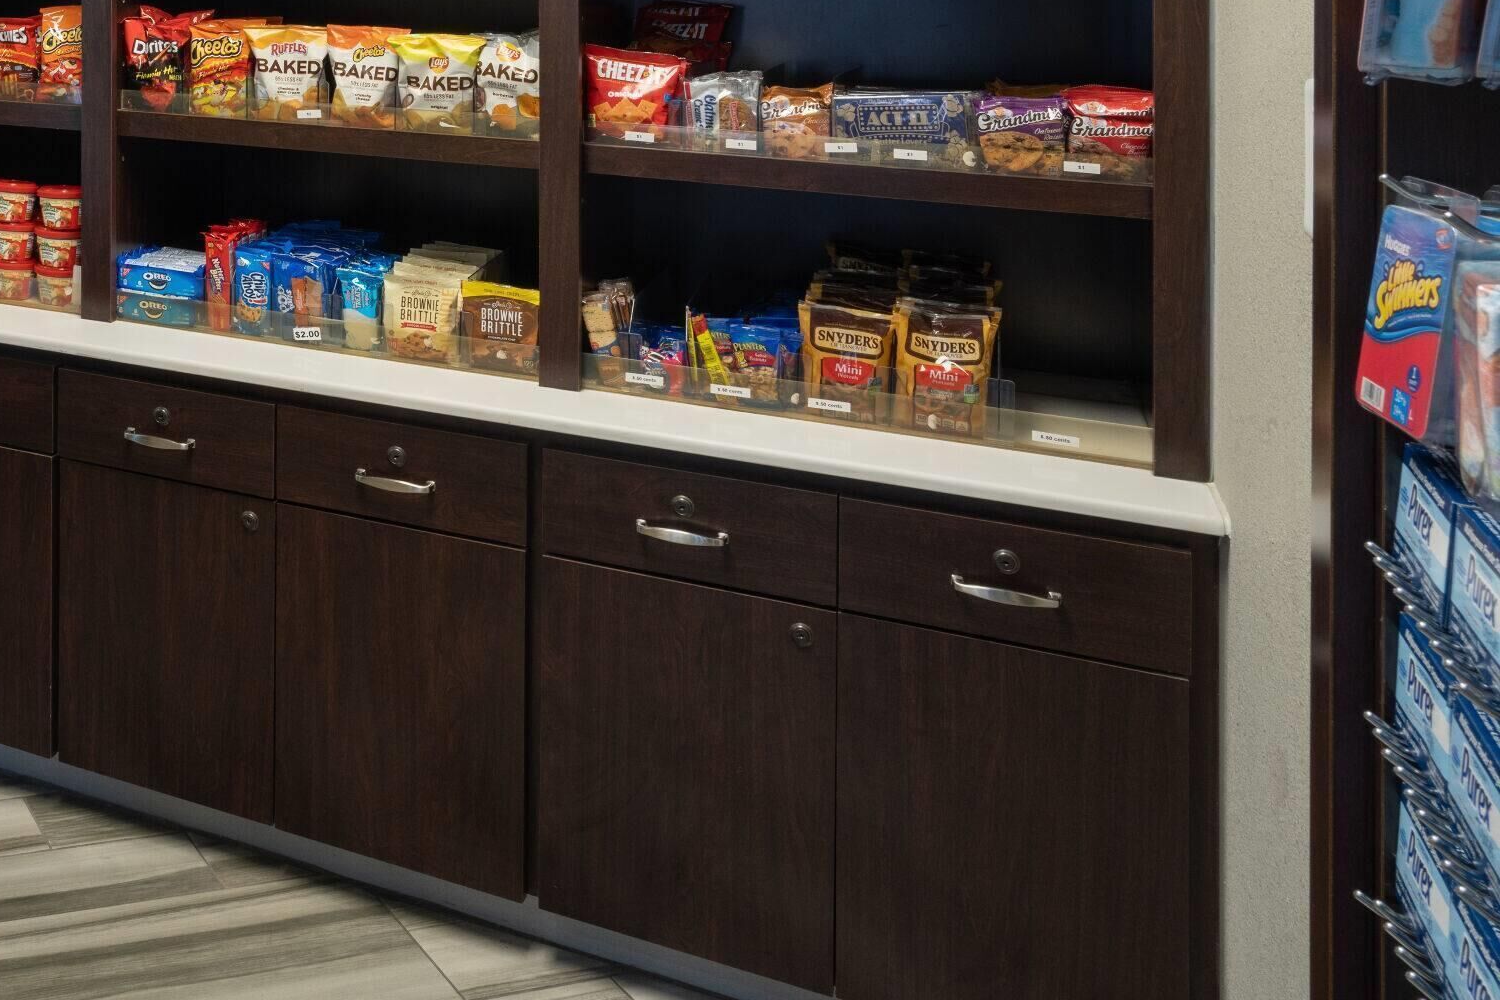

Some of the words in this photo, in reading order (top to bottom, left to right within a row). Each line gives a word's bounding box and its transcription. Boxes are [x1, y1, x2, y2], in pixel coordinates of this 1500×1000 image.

[134, 39, 178, 54] Doritos
[190, 37, 242, 66] Cheetos
[271, 43, 307, 56] RUFFLES
[353, 45, 386, 62] Cheetos
[257, 59, 320, 75] BAKED
[430, 57, 449, 68] Lay's
[334, 62, 398, 81] BAKED
[407, 76, 474, 91] BAKED
[867, 111, 904, 126] ACT
[978, 108, 1062, 131] Grandma's
[1384, 233, 1411, 257] HUGGIES
[143, 272, 171, 281] OREO
[1387, 258, 1416, 291] Little
[250, 272, 264, 303] Chips
[139, 300, 167, 310] OREO
[401, 296, 439, 311] BROWNIE
[1374, 276, 1442, 328] Swimmers
[400, 309, 439, 324] BRITTLE
[481, 308, 523, 324] BROWNIE
[295, 330, 320, 338] $2.00
[481, 320, 523, 337] BRITTLE
[734, 343, 767, 351] PLANTERS
[818, 330, 879, 349] SNYDER'S
[914, 336, 976, 354] SNYDER'S
[835, 364, 863, 376] Mini
[929, 369, 959, 382] Mini
[1465, 552, 1497, 629] Purex
[1460, 746, 1492, 832] Purex
